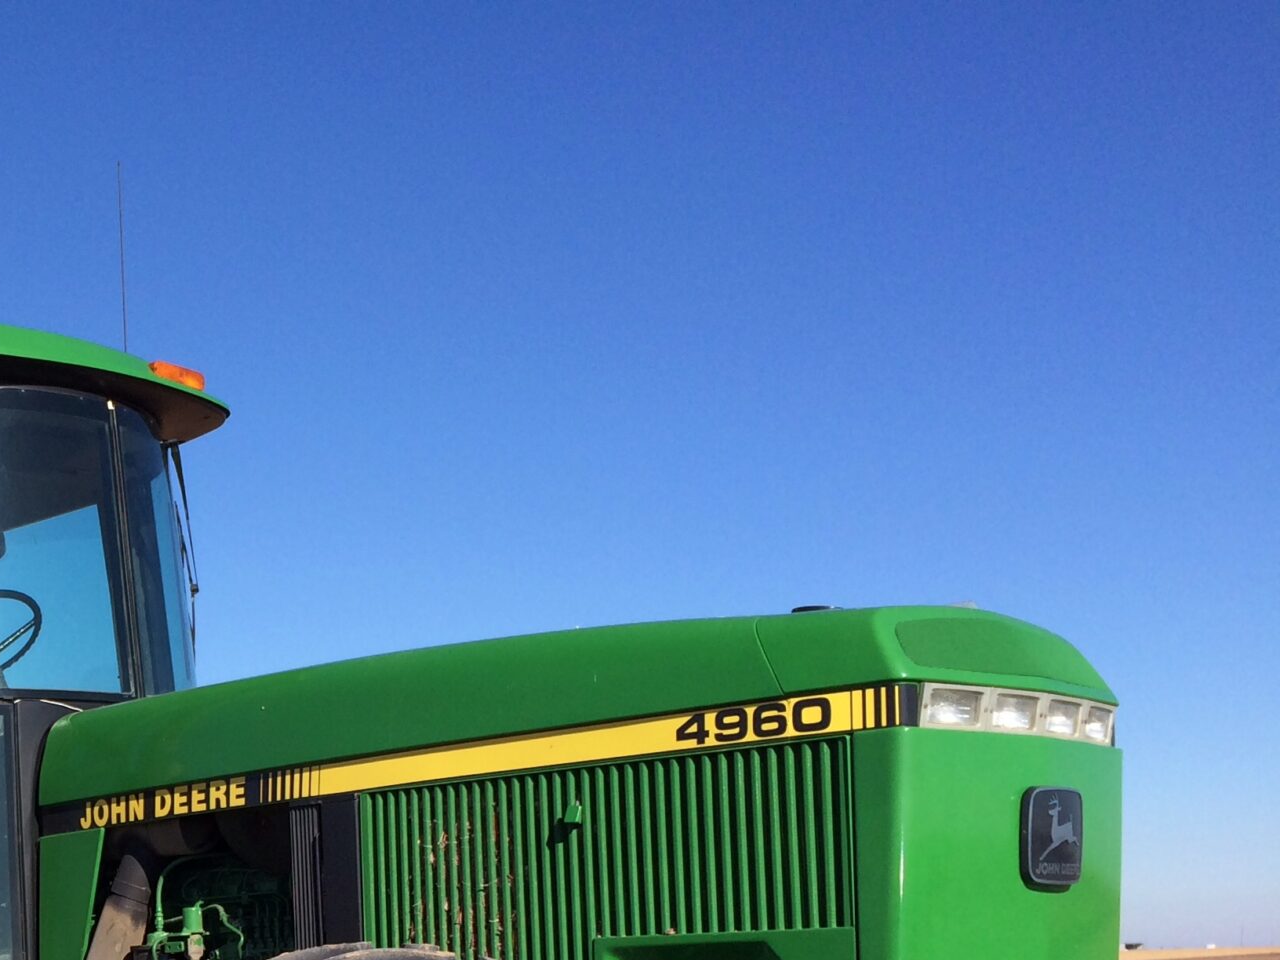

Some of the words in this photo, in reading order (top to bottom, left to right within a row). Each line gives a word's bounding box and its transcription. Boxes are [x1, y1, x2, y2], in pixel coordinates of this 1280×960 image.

[676, 696, 832, 745] 4960
[80, 792, 145, 830] JOHN
[154, 776, 246, 818] DEERE
[1036, 862, 1060, 875] JOHN
